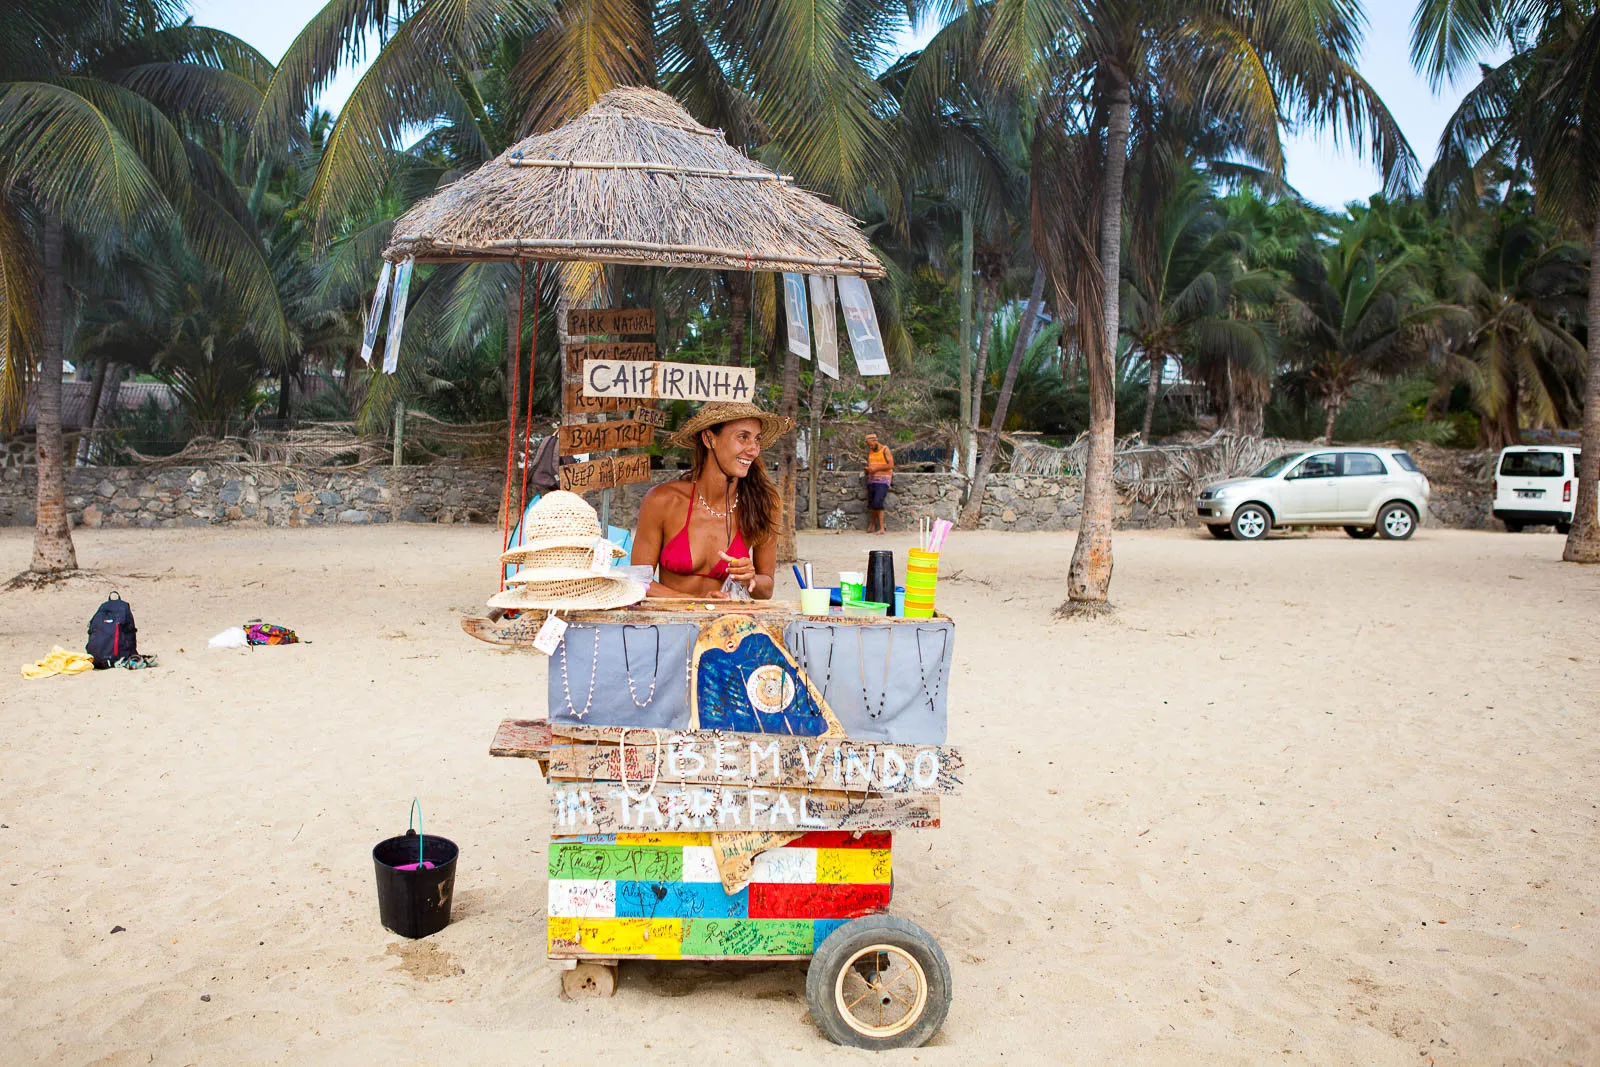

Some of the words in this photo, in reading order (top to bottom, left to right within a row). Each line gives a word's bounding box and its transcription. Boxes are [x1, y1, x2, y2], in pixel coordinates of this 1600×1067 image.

[572, 315, 607, 333] PARK
[613, 313, 654, 333] NATURAL
[590, 364, 748, 399] CAIPIRINHA
[639, 408, 664, 424] PESCA
[570, 428, 609, 448] BOAT
[615, 424, 646, 443] TRIP
[563, 464, 594, 491] SLEEP
[667, 733, 781, 779] BEM
[798, 742, 940, 790] VINDO
[608, 785, 824, 829] TARRAFAL
